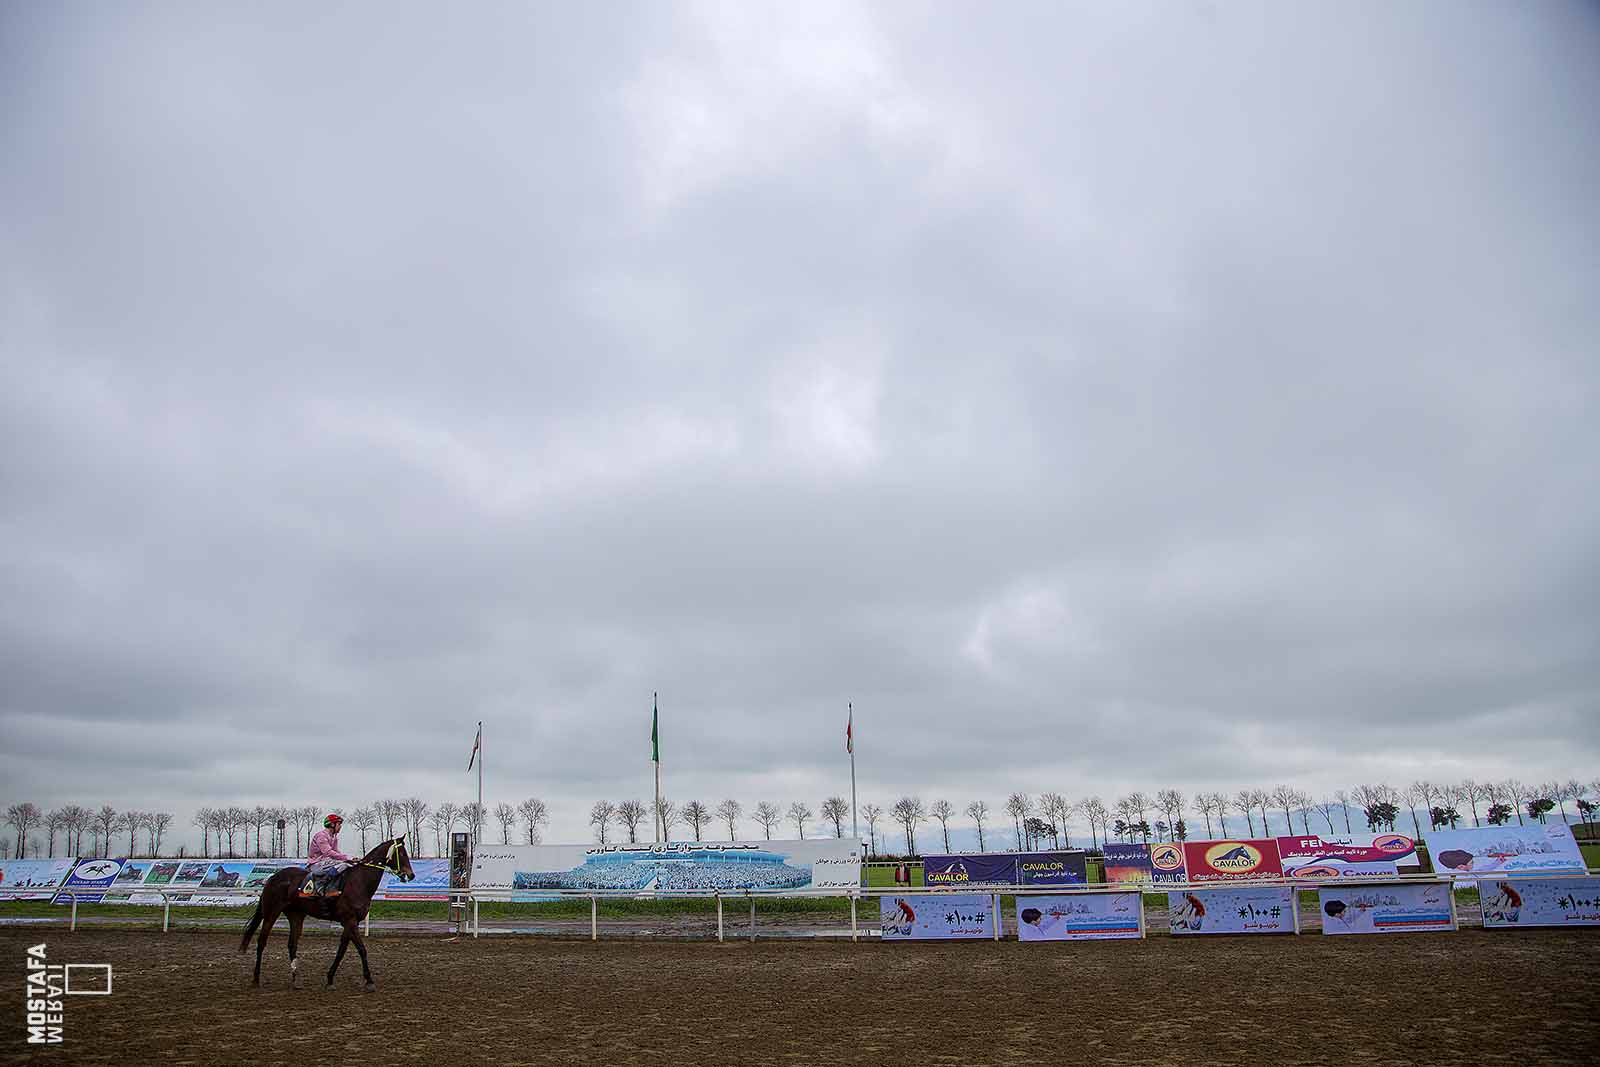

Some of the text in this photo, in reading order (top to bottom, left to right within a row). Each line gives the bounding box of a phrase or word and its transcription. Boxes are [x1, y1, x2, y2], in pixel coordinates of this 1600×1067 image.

[705, 844, 760, 852] مجموعه
[1301, 840, 1323, 848] FEI
[585, 846, 618, 855] کاووس
[1022, 863, 1064, 871] CAVALOR
[1213, 860, 1256, 868] CAVALOR
[928, 873, 969, 881] CAVALOR
